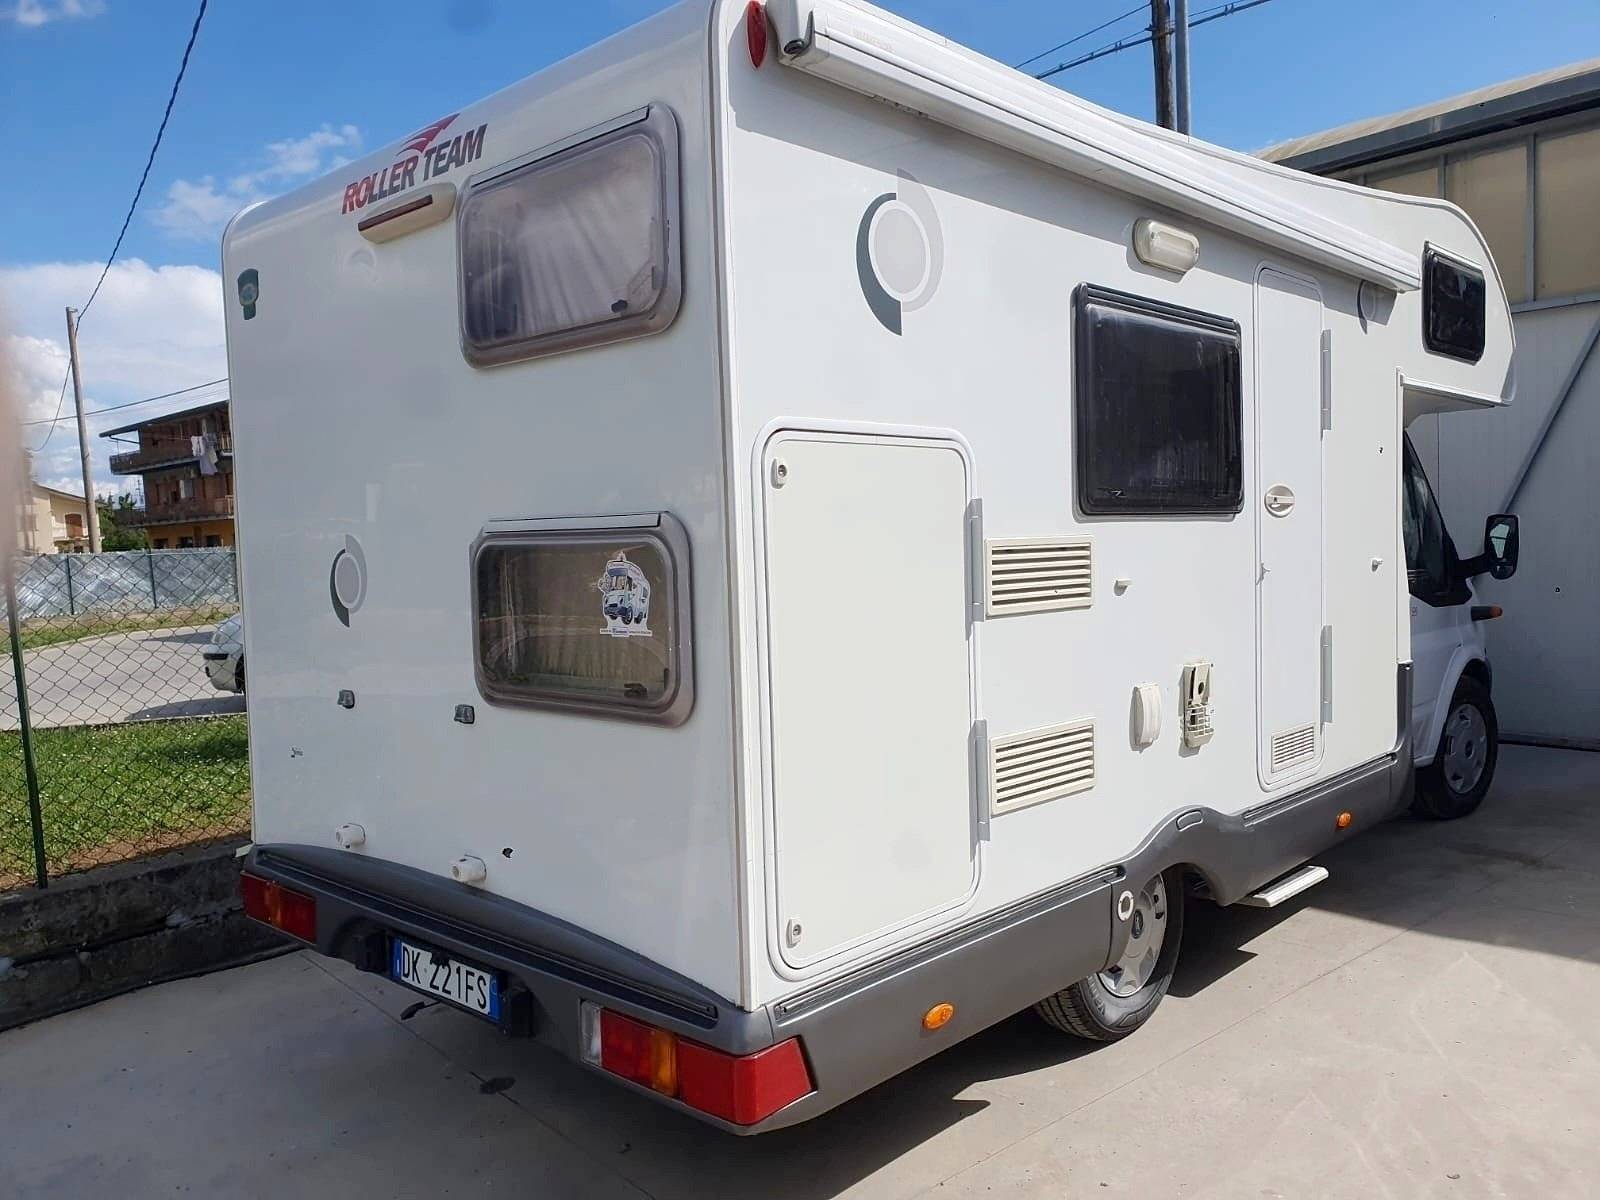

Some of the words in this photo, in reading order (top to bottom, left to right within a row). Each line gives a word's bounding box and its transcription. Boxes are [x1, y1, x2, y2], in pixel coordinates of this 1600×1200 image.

[342, 155, 418, 215] ROLLER
[423, 123, 488, 182] TEAM
[402, 945, 421, 985] DK
[429, 958, 487, 1010] 221FS
